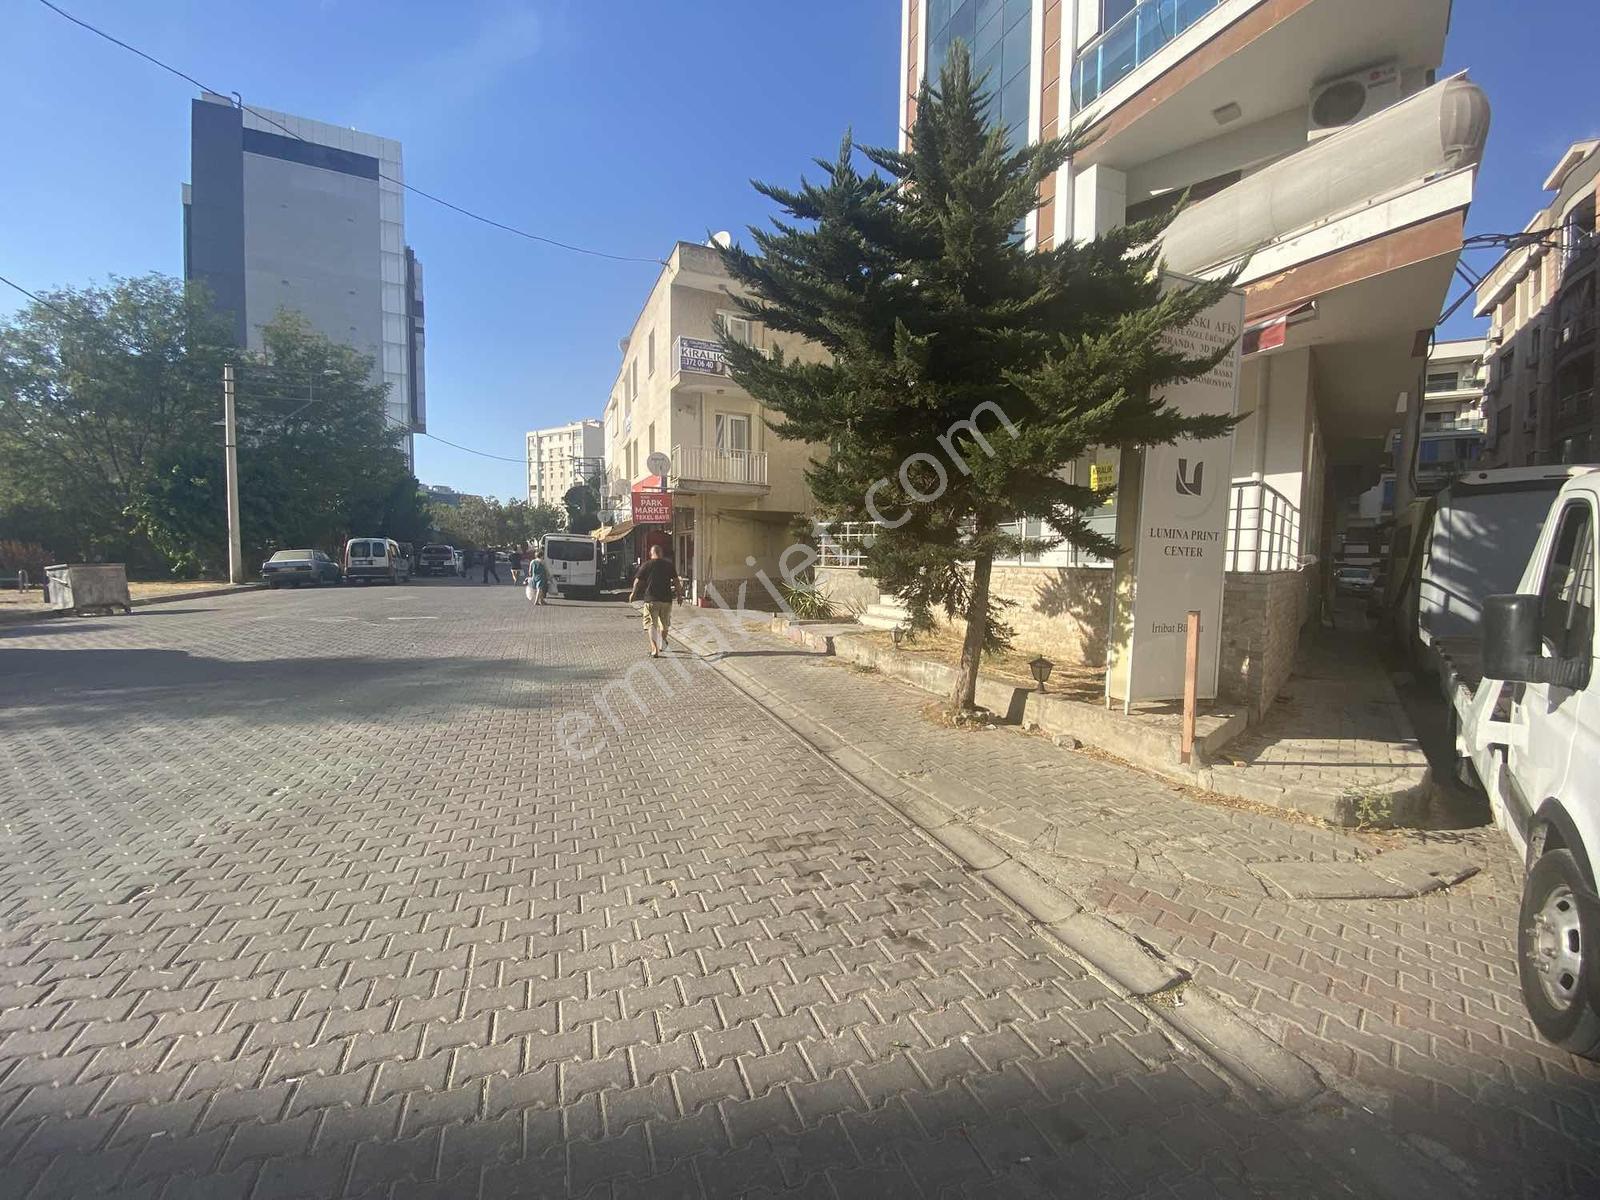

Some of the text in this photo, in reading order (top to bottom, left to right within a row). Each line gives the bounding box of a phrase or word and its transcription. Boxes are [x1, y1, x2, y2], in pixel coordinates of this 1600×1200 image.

[681, 348, 727, 362] KİRALIK
[640, 499, 663, 507] PARK
[635, 506, 669, 514] MARKET
[1150, 527, 1219, 542] LUMINA PRINT
[1164, 545, 1203, 558] CENTER
